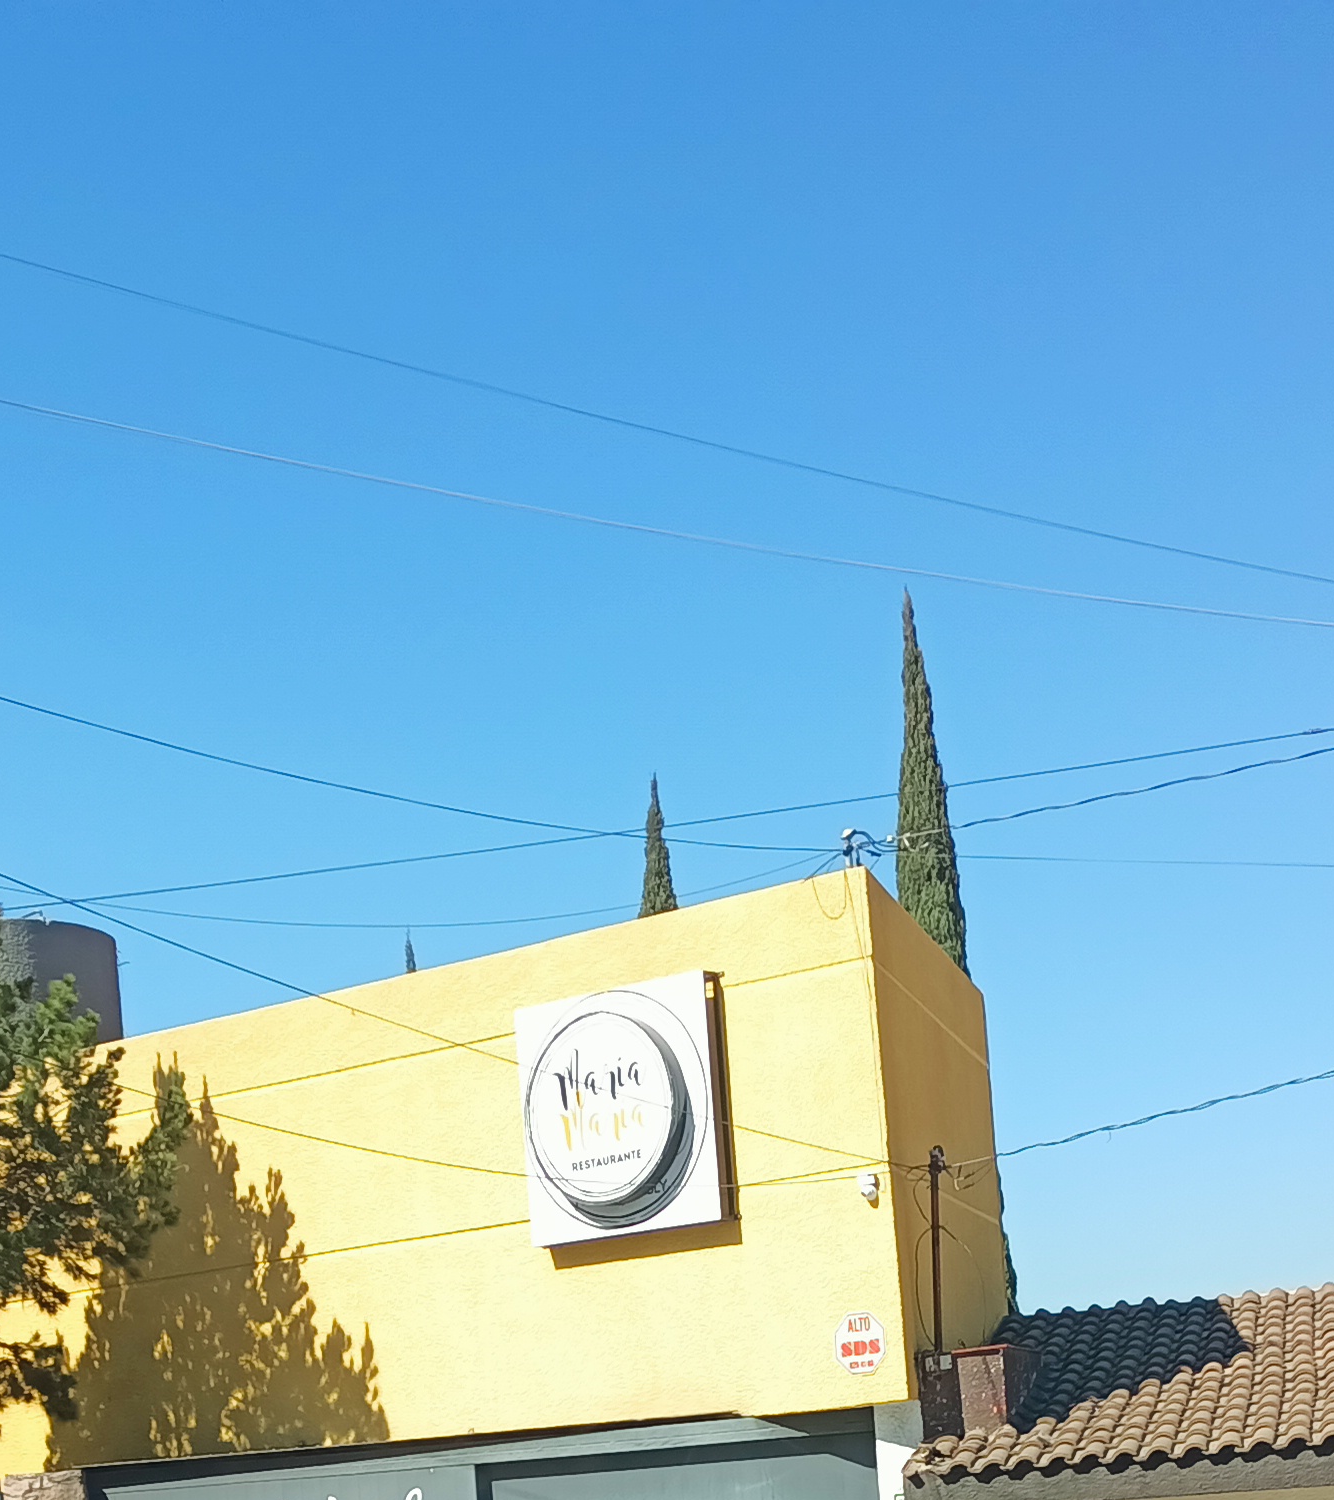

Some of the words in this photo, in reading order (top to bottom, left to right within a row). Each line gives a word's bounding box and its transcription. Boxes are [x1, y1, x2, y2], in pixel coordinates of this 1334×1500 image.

[572, 1149, 642, 1171] RESTAURANTE
[848, 1316, 871, 1333] ALTO
[840, 1338, 881, 1358] SDS
